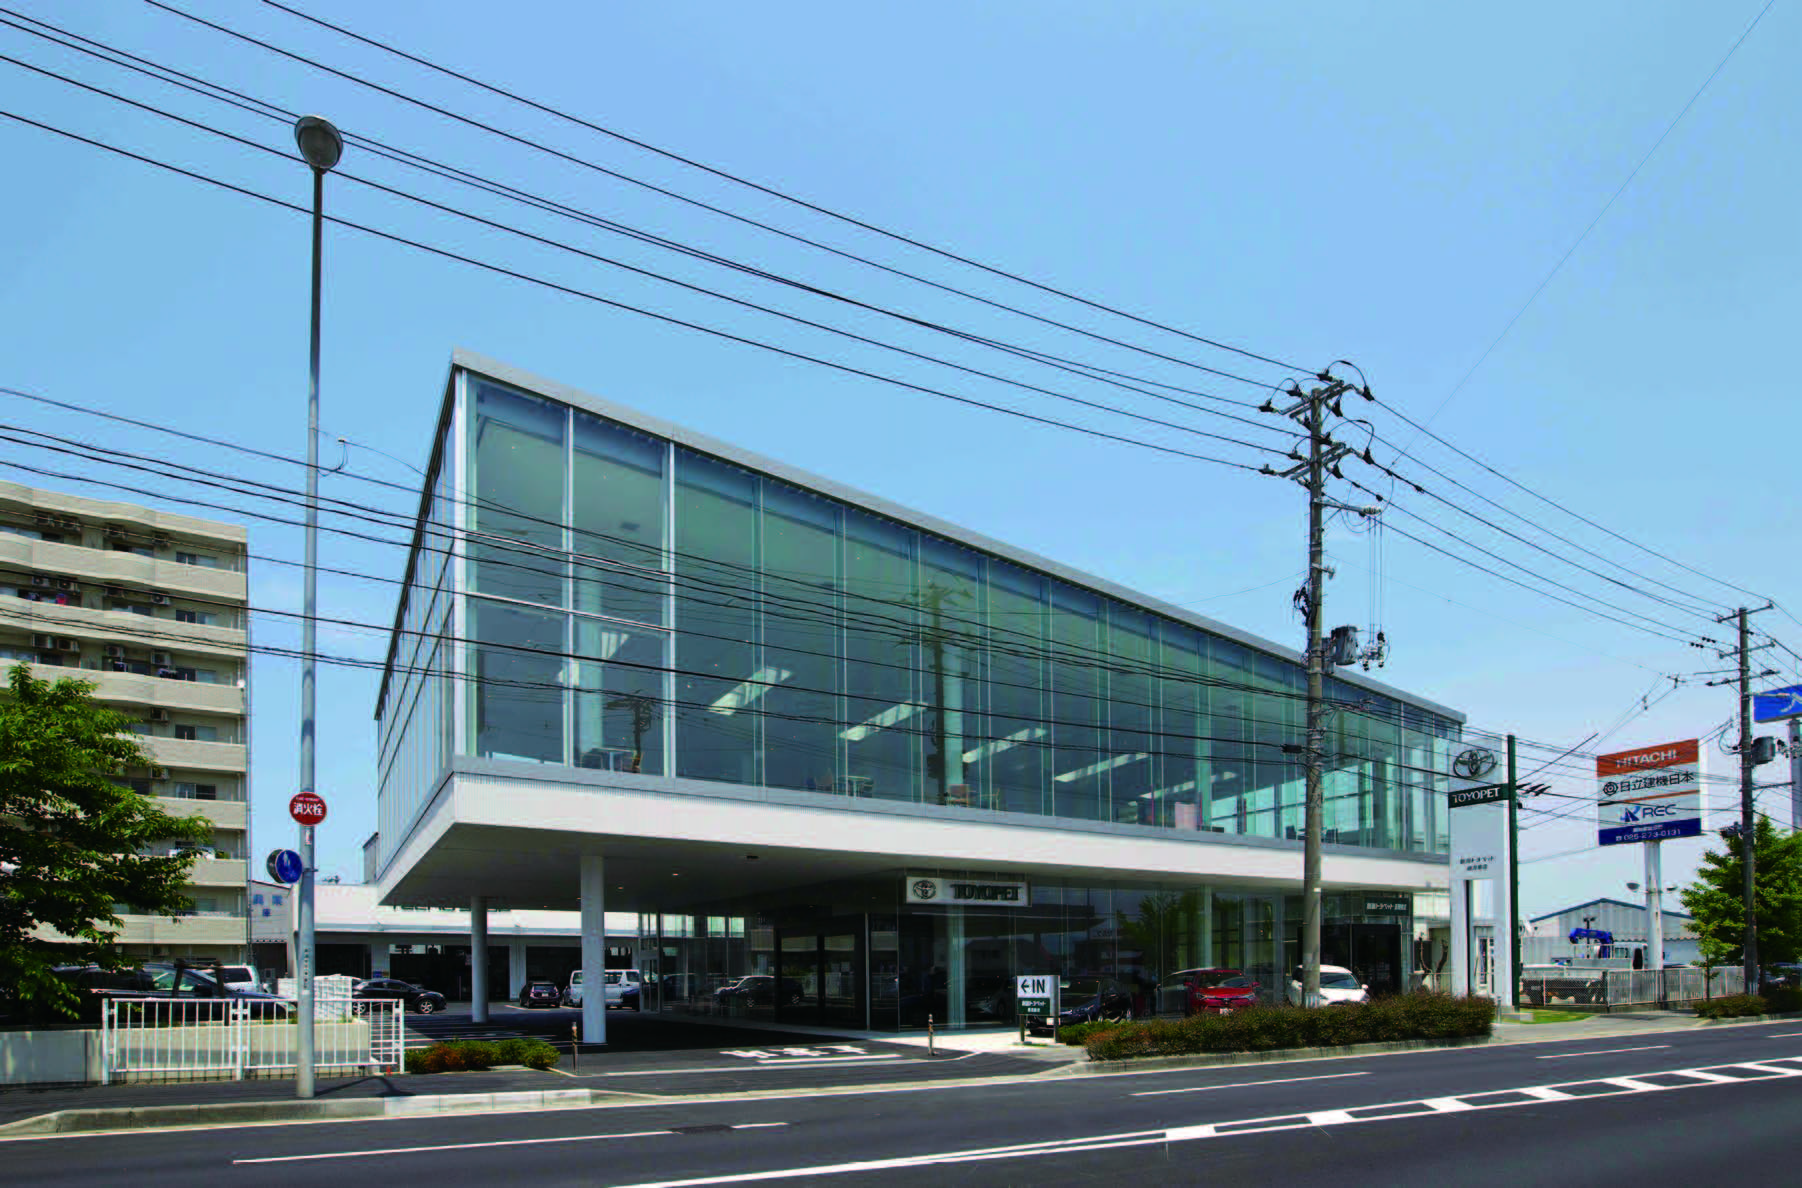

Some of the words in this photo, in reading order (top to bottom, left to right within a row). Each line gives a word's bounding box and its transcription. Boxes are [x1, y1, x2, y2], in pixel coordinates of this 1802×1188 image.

[1616, 749, 1677, 768] HITACHI
[1620, 770, 1694, 793] 日立建機日本
[1452, 787, 1500, 804] TOYOPET
[293, 801, 324, 816] 消火栓
[950, 883, 1021, 901] TOYOPET
[1032, 979, 1045, 993] IN
